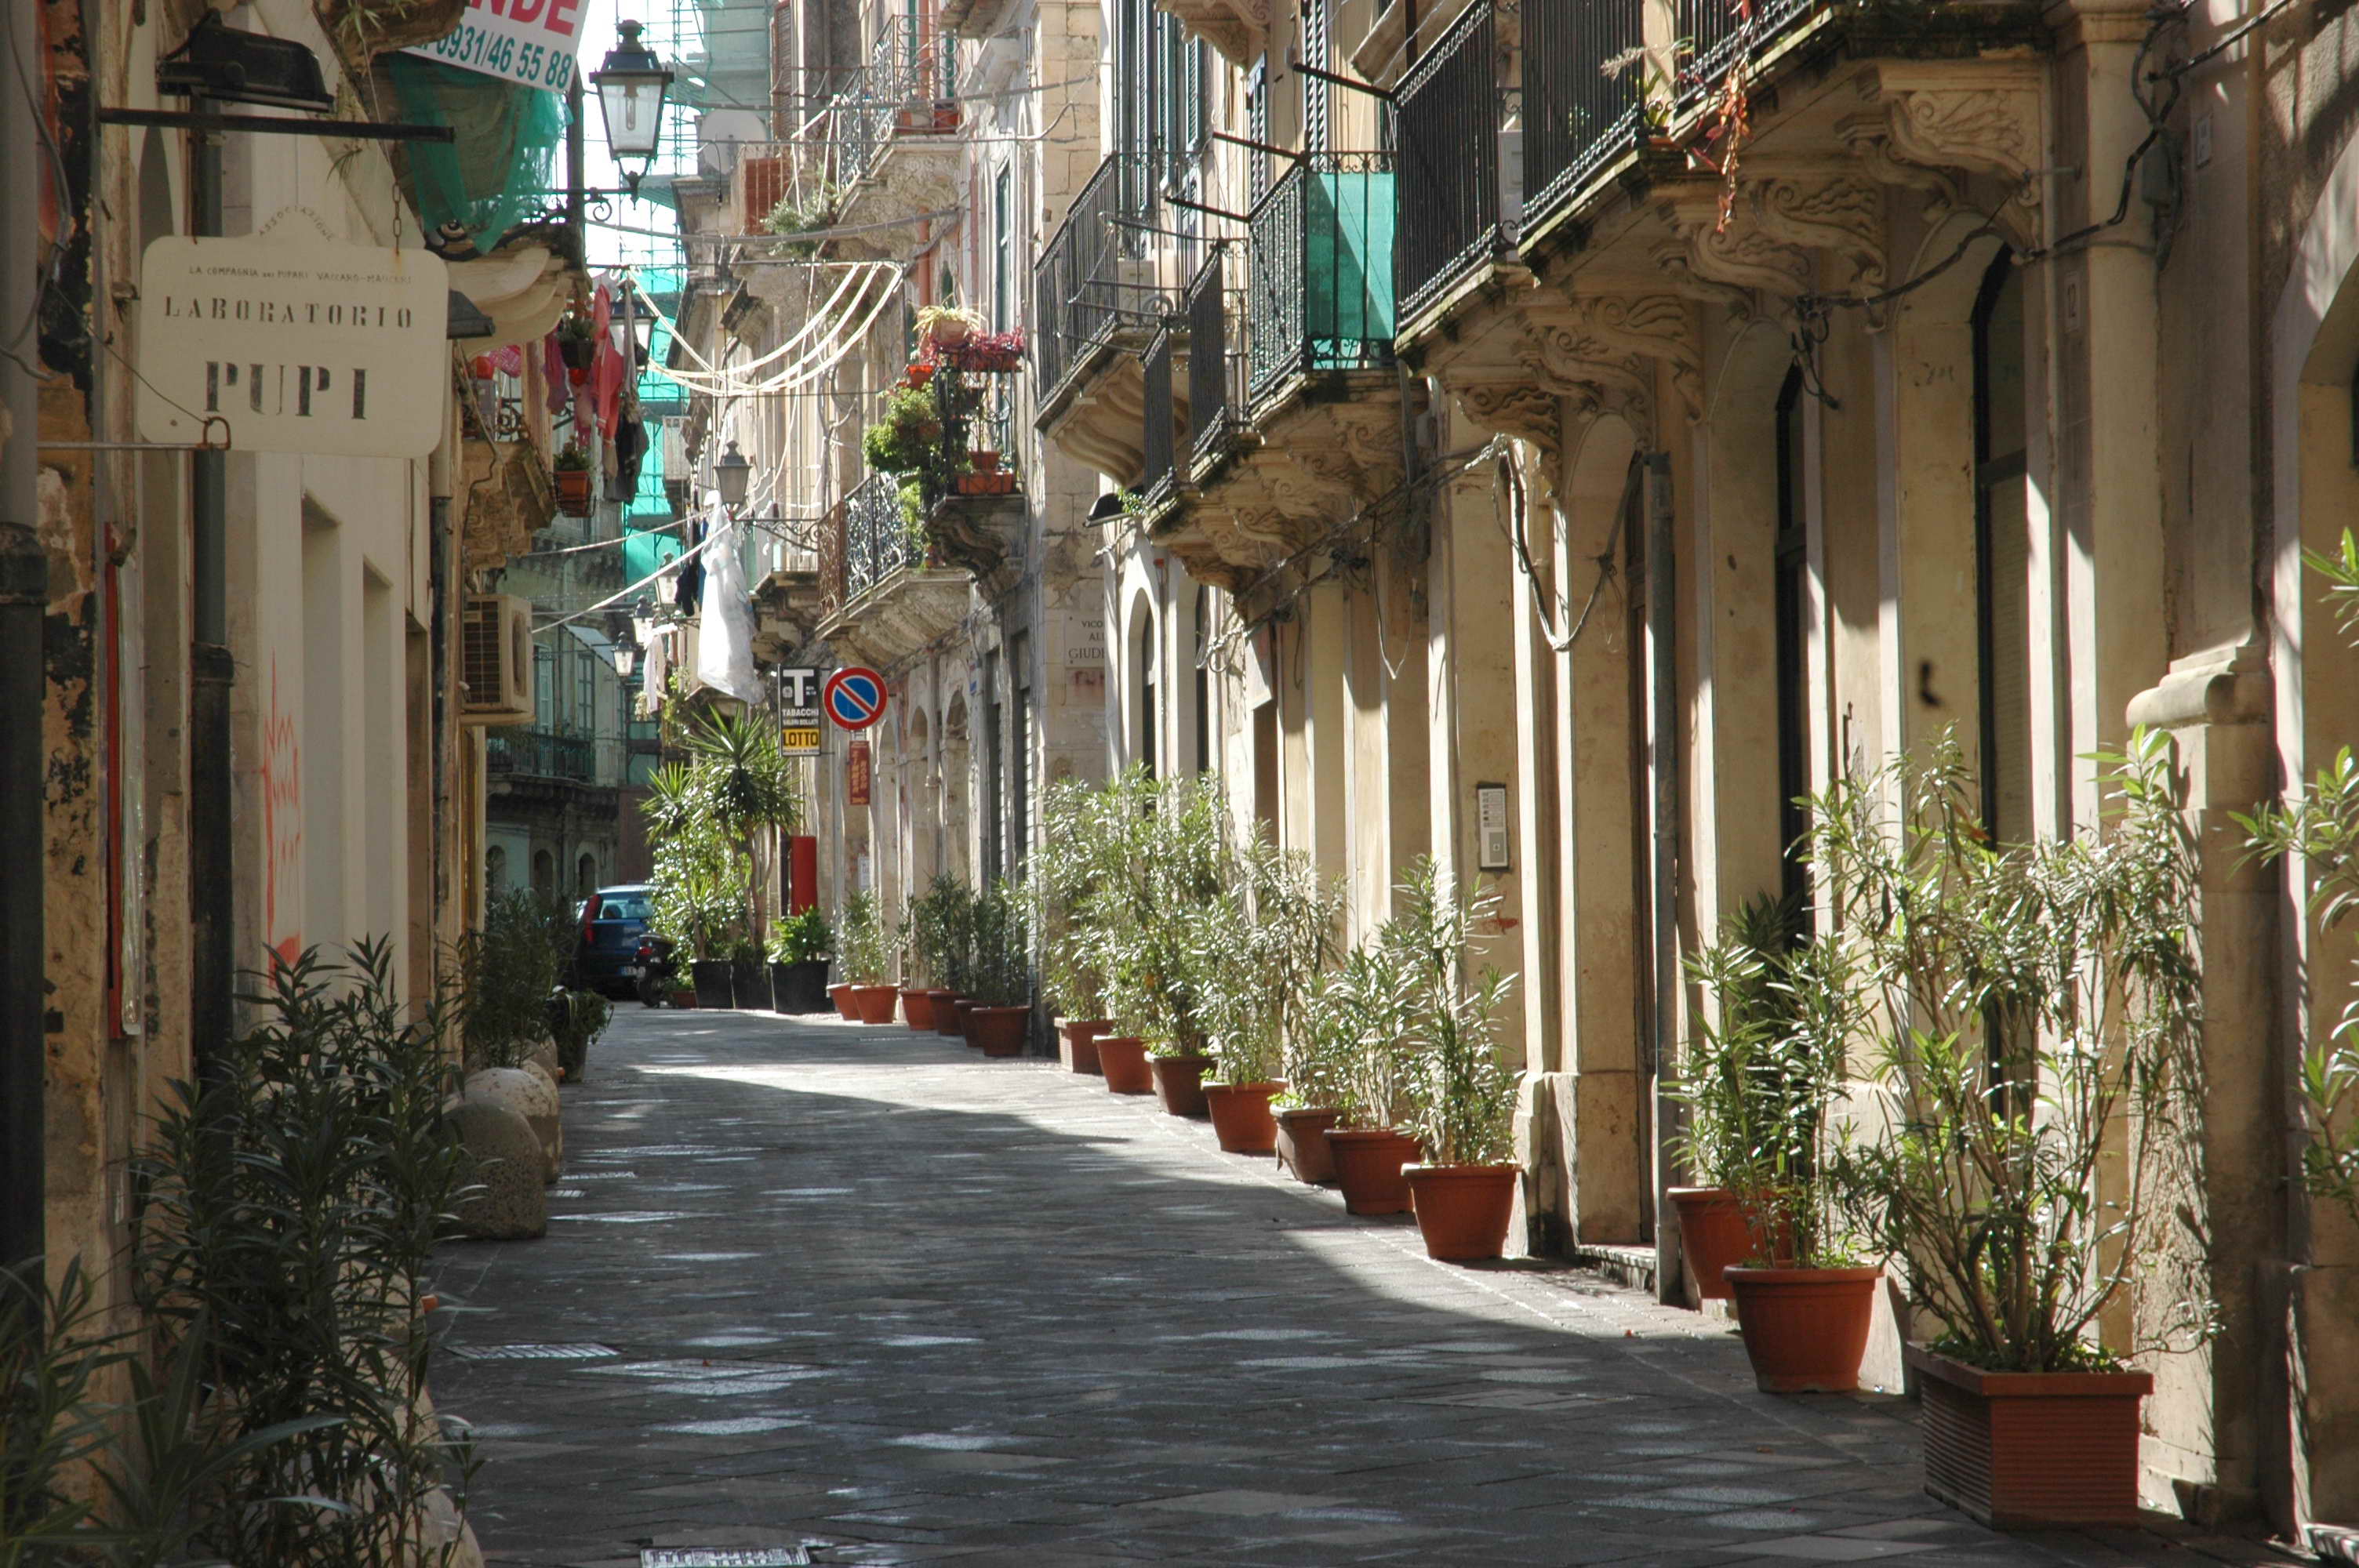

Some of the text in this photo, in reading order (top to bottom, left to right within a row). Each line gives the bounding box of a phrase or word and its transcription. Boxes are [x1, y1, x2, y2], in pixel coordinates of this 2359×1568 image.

[516, 42, 545, 81] 55
[545, 50, 572, 89] 88
[189, 265, 202, 274] LA
[206, 267, 259, 277] COMPAGNIA
[165, 296, 412, 328] LABORATORIO
[204, 361, 367, 420] PUPI
[783, 668, 815, 707] T
[781, 708, 820, 717] TABACCHI
[783, 731, 819, 747] LOTTO
